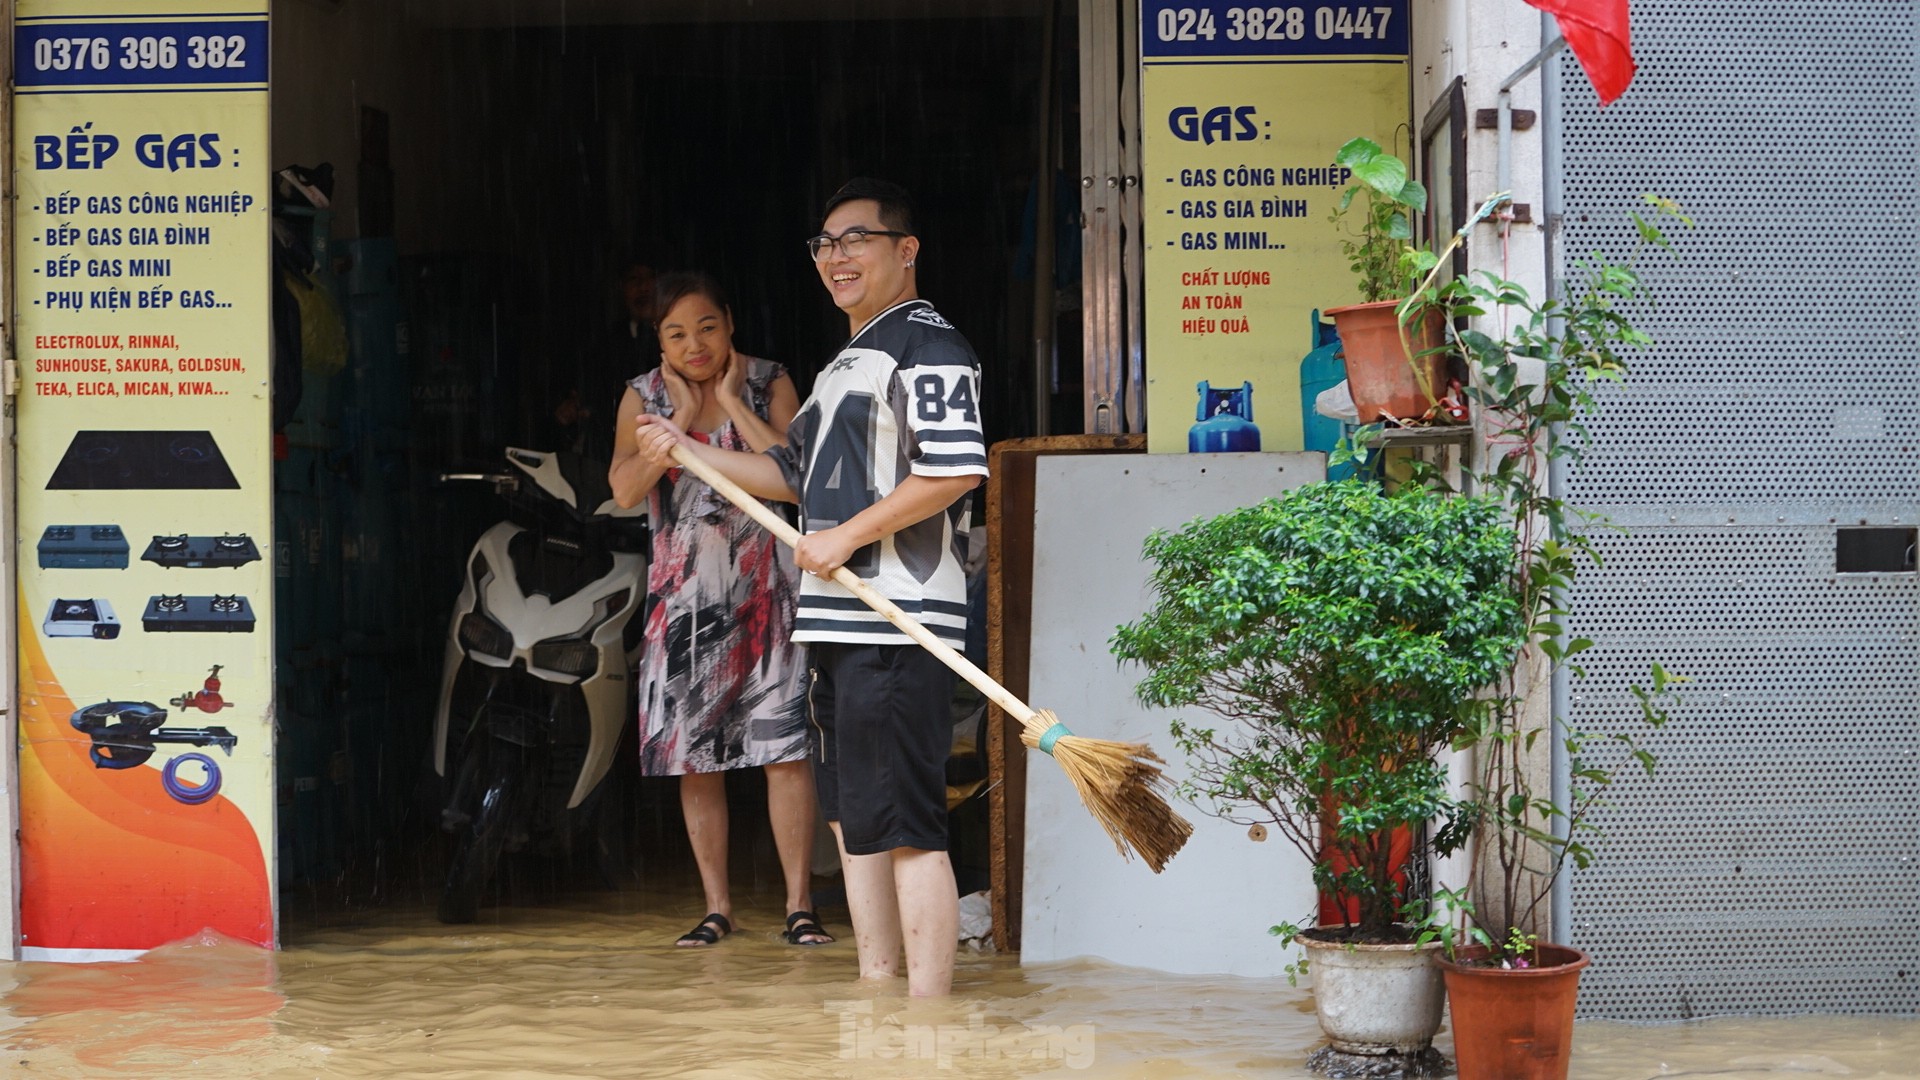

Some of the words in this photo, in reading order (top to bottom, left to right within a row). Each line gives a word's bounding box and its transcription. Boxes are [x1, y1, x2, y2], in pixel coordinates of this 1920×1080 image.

[1158, 9, 1216, 42] 024
[1227, 7, 1305, 41] 3828
[1316, 7, 1392, 40] 0447
[34, 38, 110, 71] 0376
[120, 37, 178, 70] 396
[187, 35, 246, 69] 382
[34, 122, 119, 170] BẾP
[135, 133, 221, 172] GAS
[1181, 169, 1216, 187] GAS
[1224, 165, 1275, 186] CÔNG
[1282, 164, 1352, 189] NGHIỆP
[46, 190, 80, 214] BẾP
[88, 196, 121, 214] GAS
[129, 192, 178, 214] CÔNG
[186, 192, 253, 216] NGHIỆP
[1181, 200, 1217, 218] GAS
[1224, 200, 1255, 218] GIA
[1261, 197, 1307, 218] ĐÌNH
[47, 222, 80, 246] BẾP
[88, 228, 122, 245] GAS
[129, 228, 158, 245] GIA
[165, 224, 209, 245] ĐÌNH
[1182, 232, 1217, 250] GAS
[1224, 232, 1285, 249] MINI...
[47, 254, 80, 277] BẾP
[88, 259, 122, 277] GAS
[130, 259, 170, 276] MINI
[1182, 267, 1219, 287] CHẤT
[1224, 271, 1271, 290] LƯỢNG
[47, 291, 83, 313] PHỤ
[91, 287, 130, 312] KIỆN
[139, 285, 173, 308] BẾP
[180, 290, 233, 309] GAS...
[1182, 297, 1201, 310] AN
[1206, 294, 1243, 310] TOÀN
[1182, 319, 1216, 335] HIỆU
[1220, 315, 1250, 334] QUẢ
[35, 335, 124, 351] ELECTROLUX,
[128, 335, 180, 350] RINNAI,
[35, 358, 111, 374] SUNHOUSE,
[116, 358, 173, 374] SAKURA,
[178, 358, 246, 374] GOLDSUN,
[35, 382, 72, 397] TEKA,
[77, 382, 119, 397] ELICA,
[124, 382, 174, 397] MICAN,
[178, 381, 229, 396] KIWA...
[914, 374, 979, 424] 84
